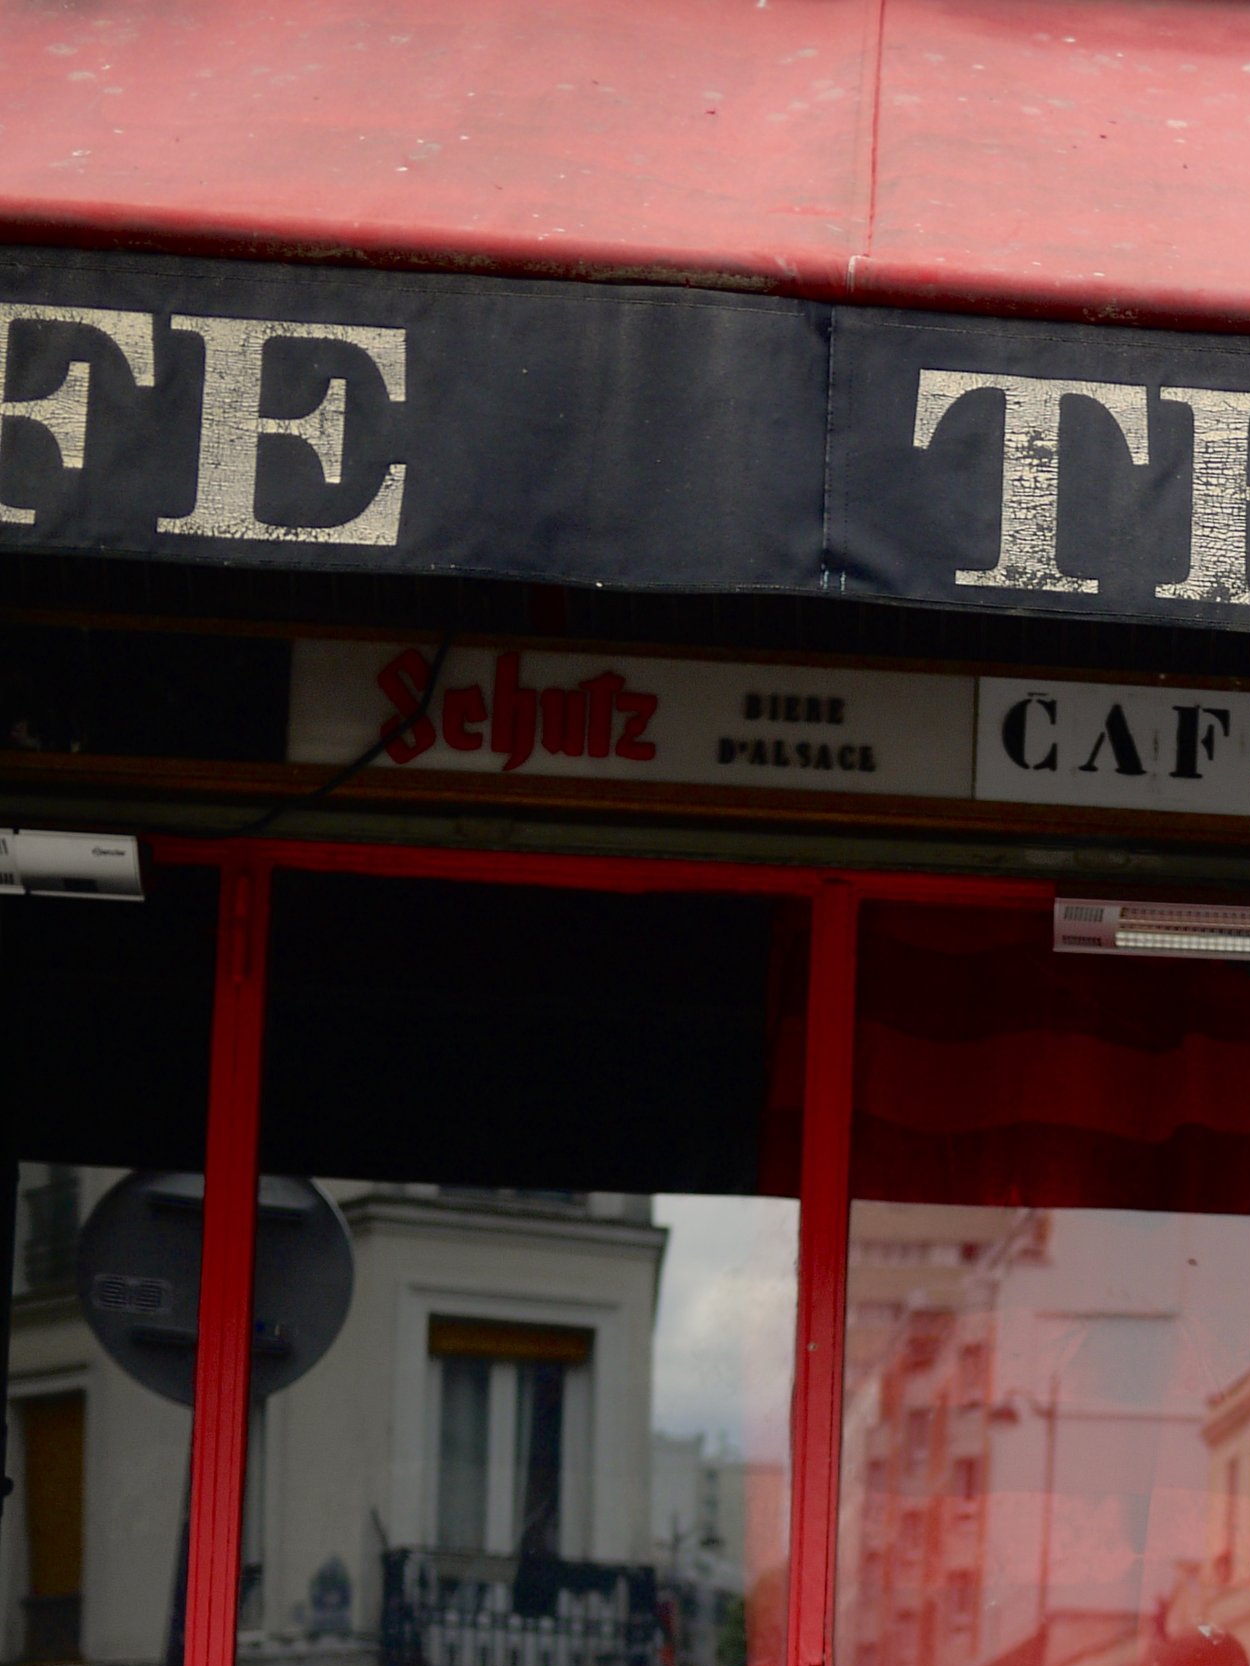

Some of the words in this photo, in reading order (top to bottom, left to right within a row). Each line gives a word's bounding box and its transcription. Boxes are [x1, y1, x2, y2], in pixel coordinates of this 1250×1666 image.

[375, 646, 659, 772] Schutz
[743, 692, 845, 725] BIERE
[717, 737, 878, 774] D'ALSACE
